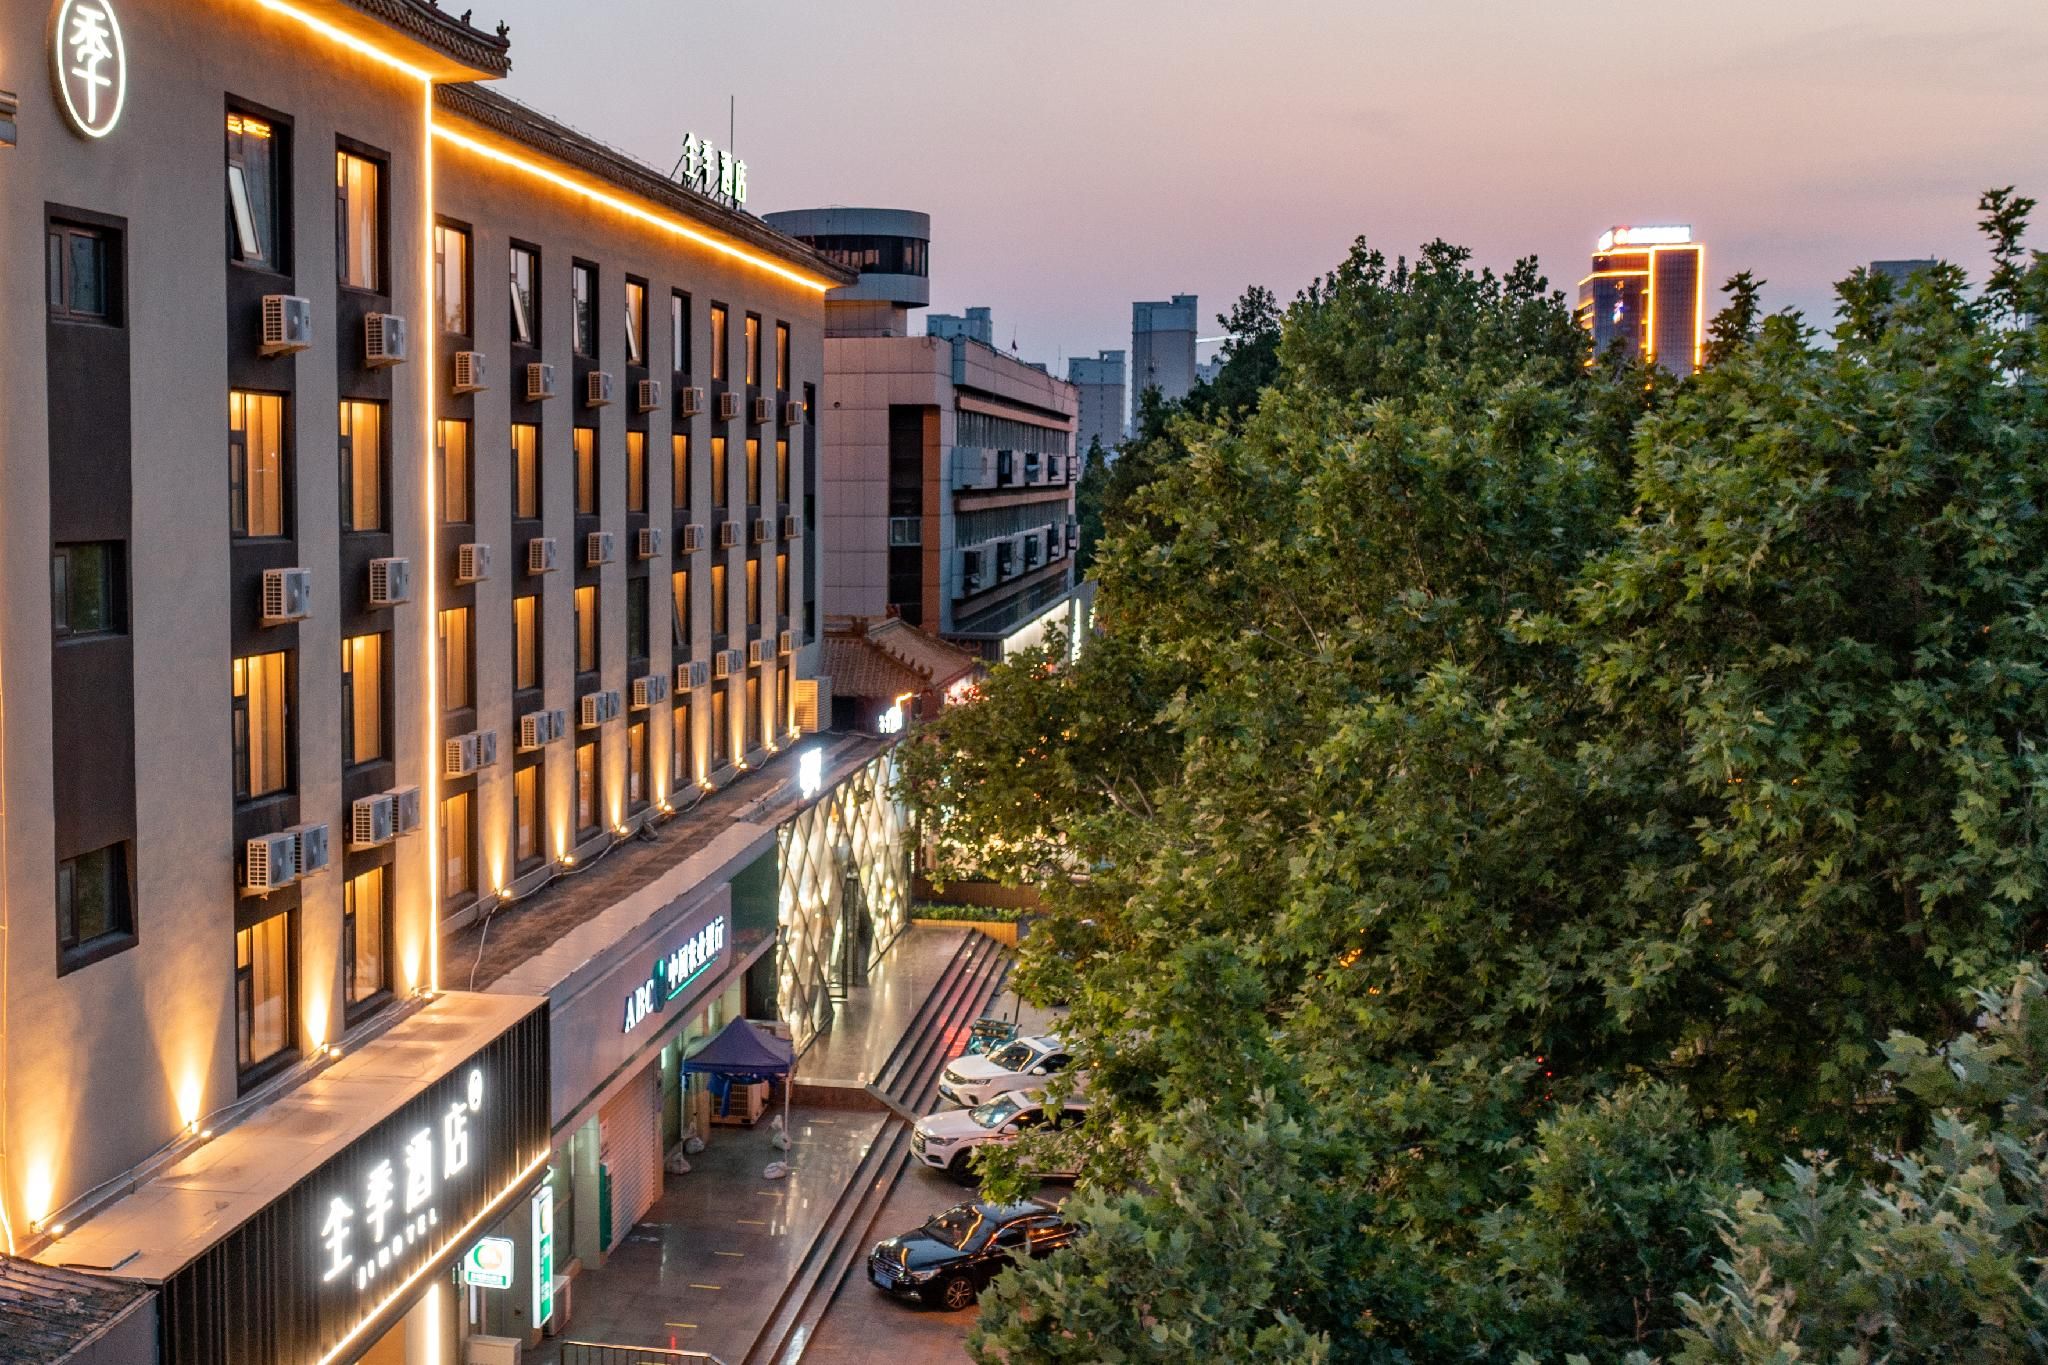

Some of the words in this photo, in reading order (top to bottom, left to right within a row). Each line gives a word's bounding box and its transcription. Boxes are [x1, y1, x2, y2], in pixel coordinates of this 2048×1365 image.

[70, 5, 112, 124] 季
[624, 978, 655, 1034] ABC
[321, 1102, 469, 1282] 全季酒店
[378, 1207, 437, 1268] HOTEL
